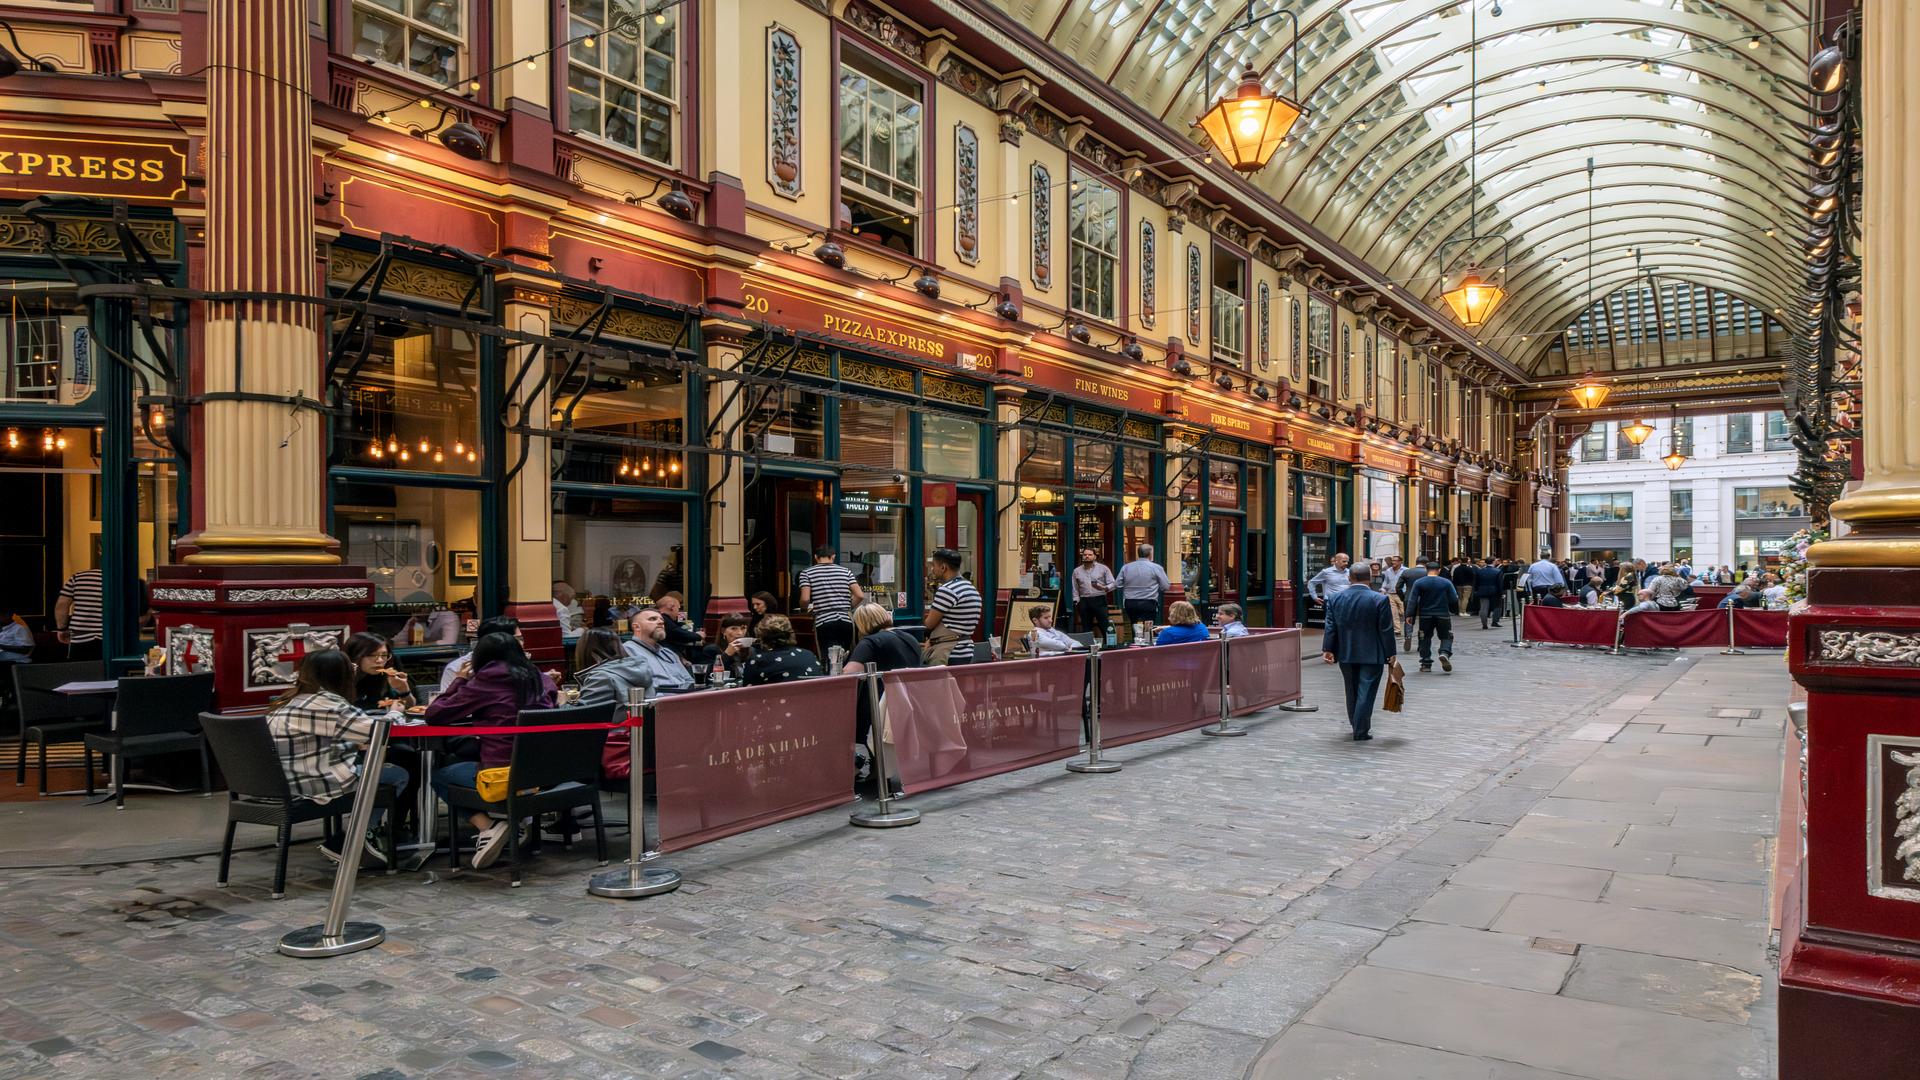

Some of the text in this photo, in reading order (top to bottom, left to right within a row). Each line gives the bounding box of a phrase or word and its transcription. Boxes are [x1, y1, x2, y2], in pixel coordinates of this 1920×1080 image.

[744, 294, 769, 314] 20
[823, 314, 944, 358] PIZZAEXPRESS
[976, 353, 992, 369] 20
[1023, 365, 1034, 379] 19
[1075, 378, 1129, 401] FINE WINES
[1153, 398, 1161, 409] 19
[1210, 412, 1250, 431] FINE SPIRITS
[708, 735, 819, 767] LEADENHALL
